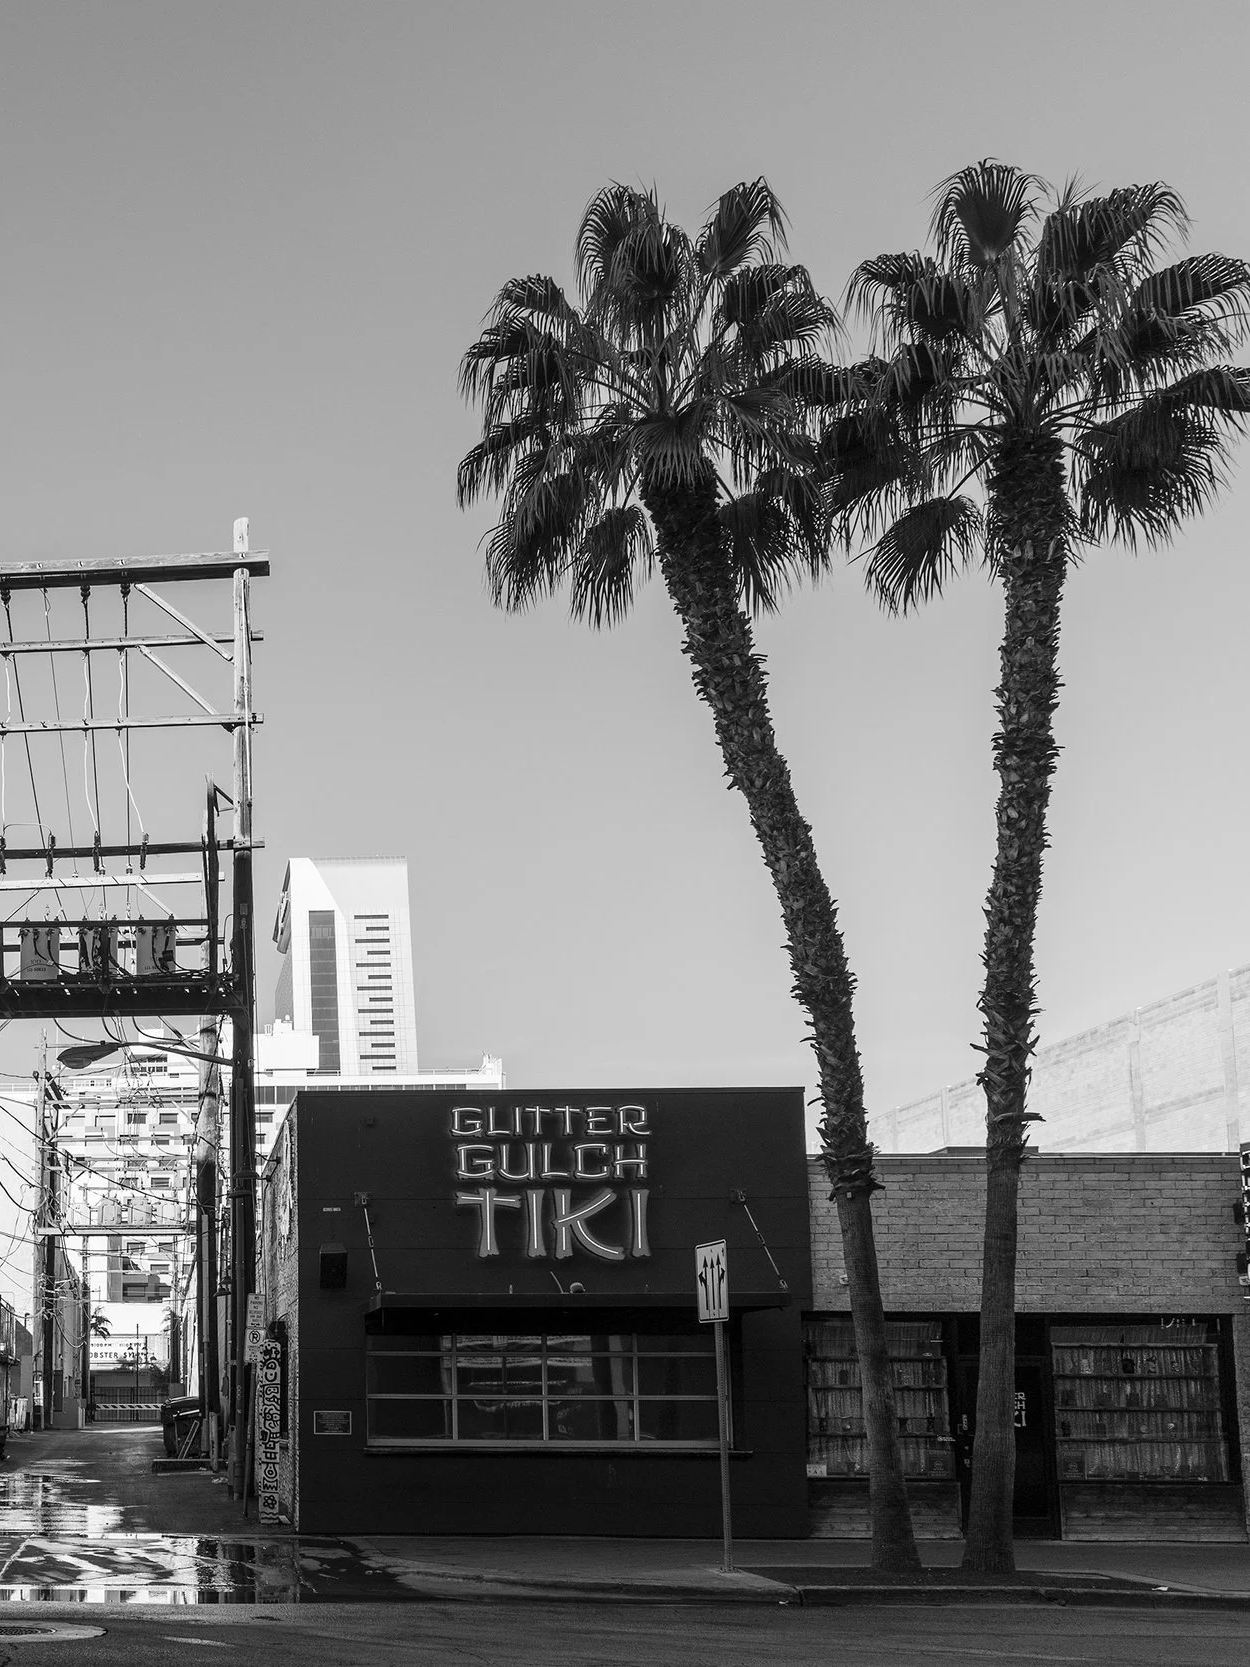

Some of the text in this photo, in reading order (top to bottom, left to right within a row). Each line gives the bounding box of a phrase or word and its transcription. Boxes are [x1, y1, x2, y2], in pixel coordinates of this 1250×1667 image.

[451, 1104, 651, 1137] GLITTER
[456, 1142, 647, 1181] GULCH
[454, 1187, 651, 1262] TIKI
[90, 1351, 119, 1359] OBSTER
